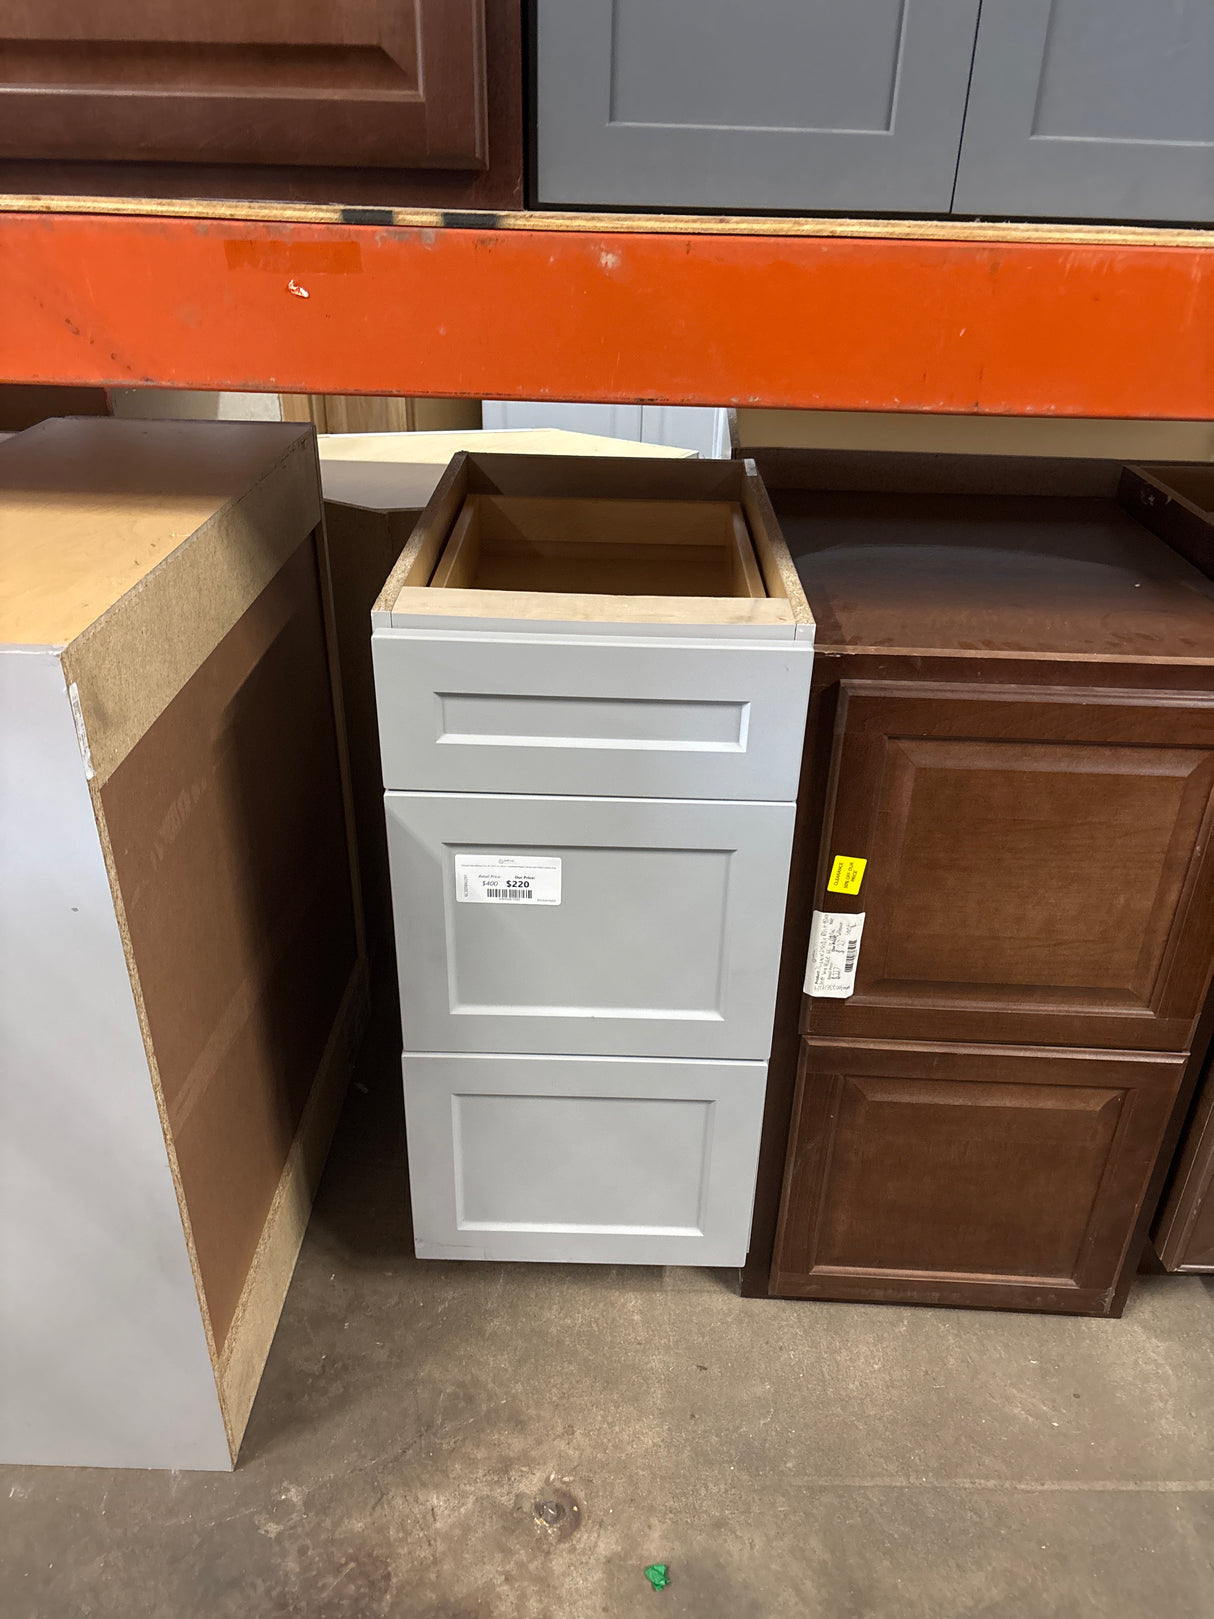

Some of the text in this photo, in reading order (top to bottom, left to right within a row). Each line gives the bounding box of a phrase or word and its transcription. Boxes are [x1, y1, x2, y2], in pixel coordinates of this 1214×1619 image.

[833, 862, 844, 886] CLEARANCE
[850, 871, 858, 882] PRICE
[506, 880, 530, 888] $220
